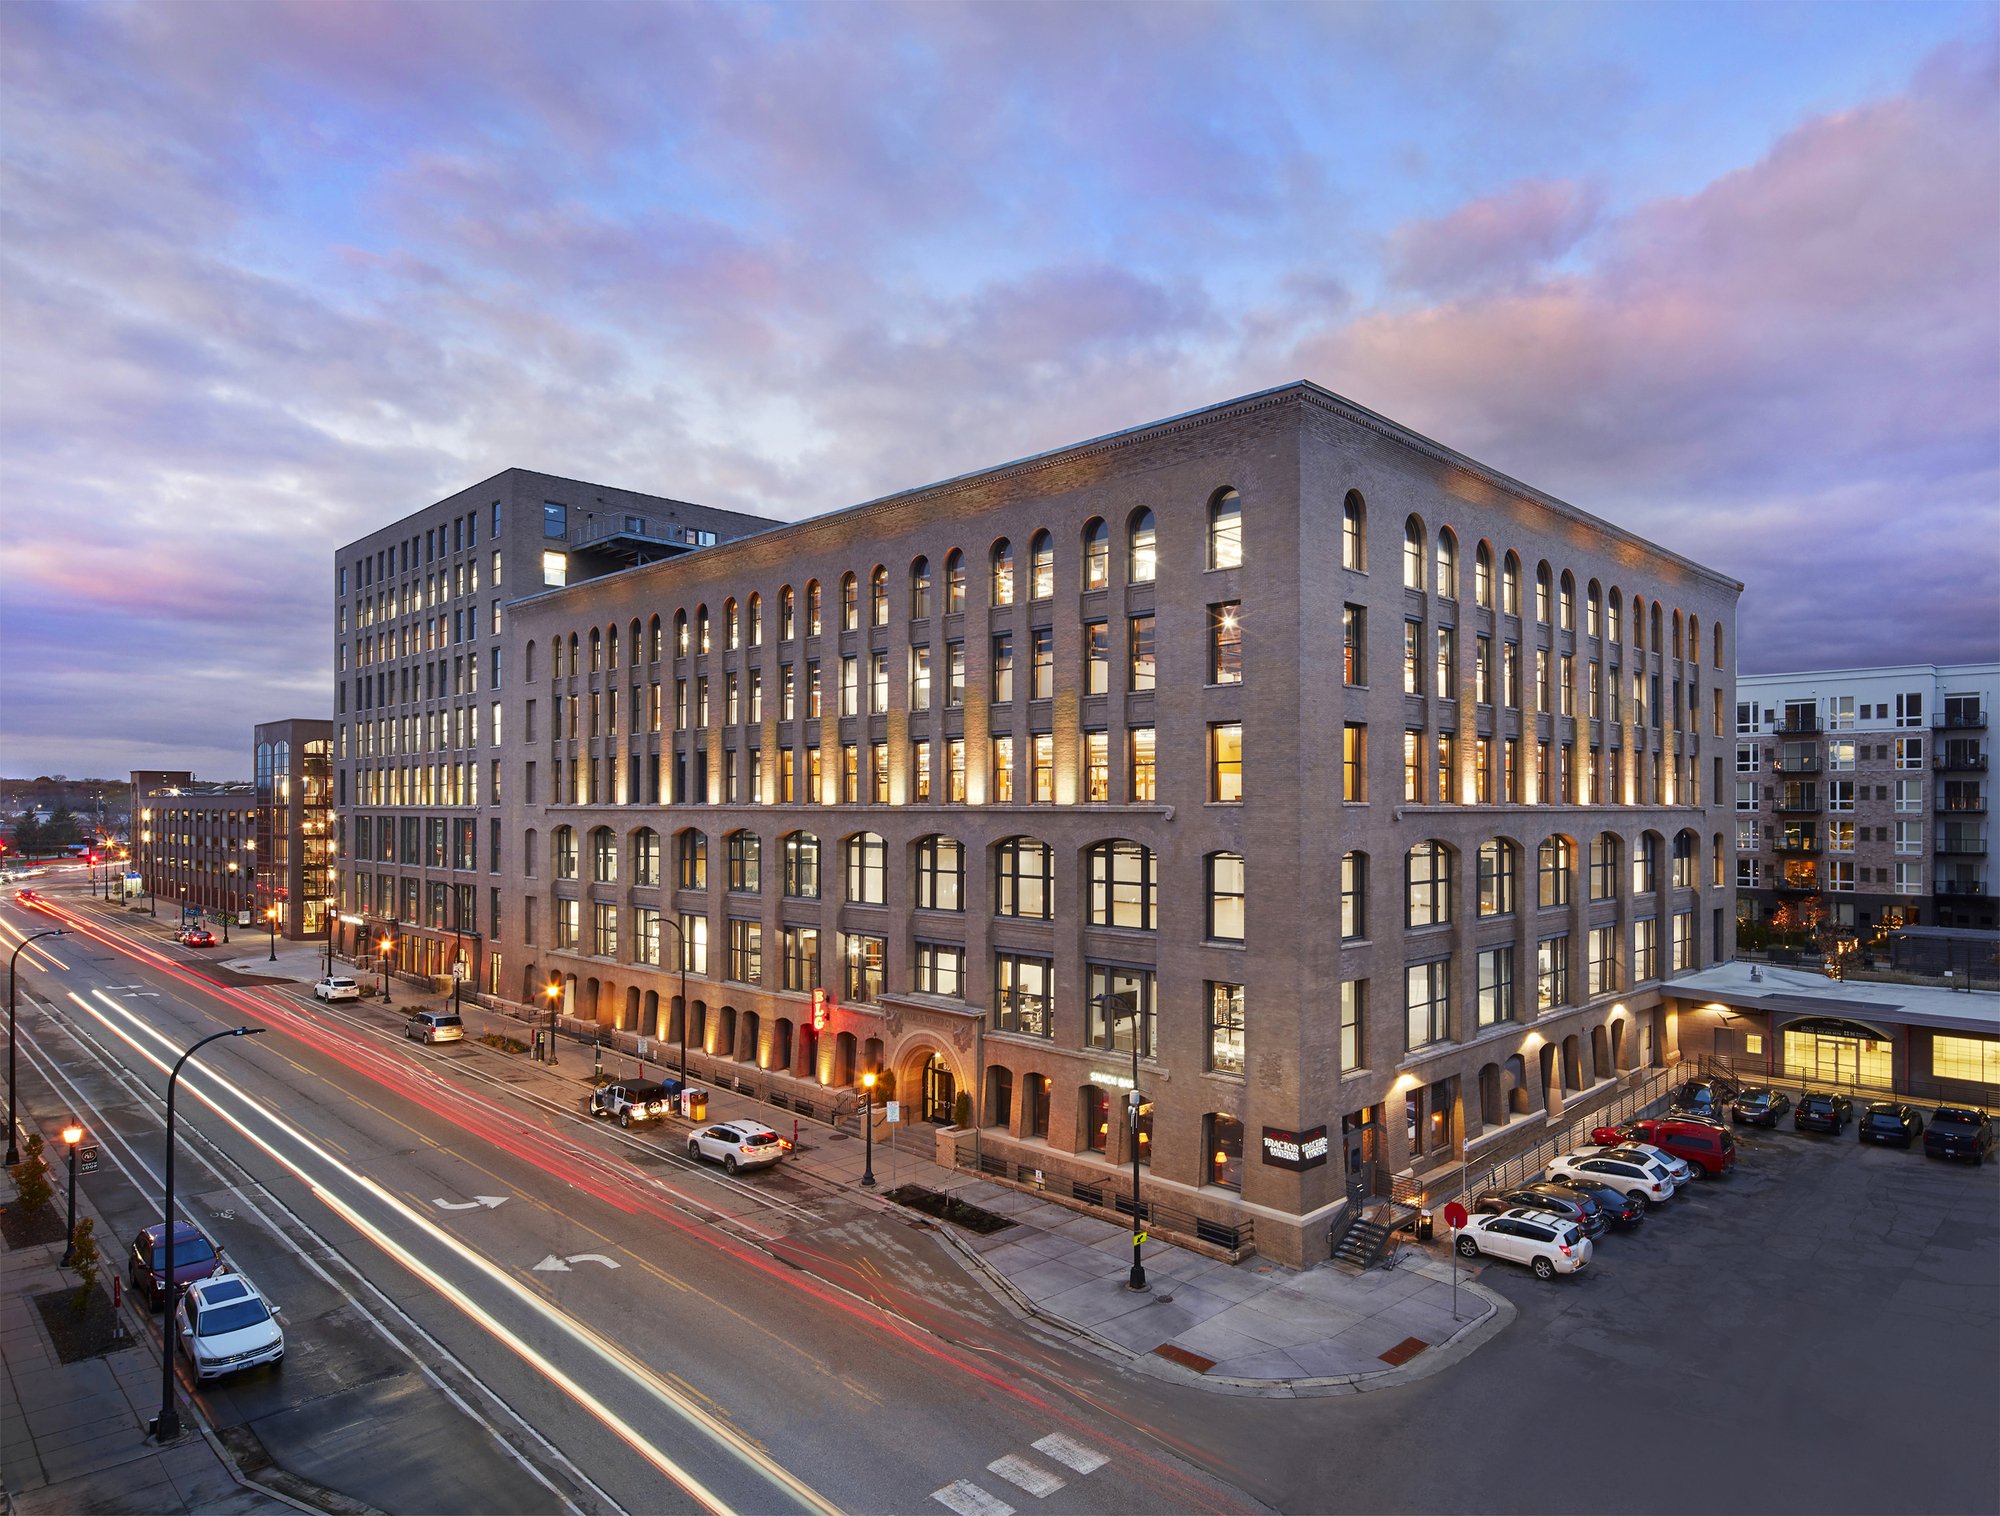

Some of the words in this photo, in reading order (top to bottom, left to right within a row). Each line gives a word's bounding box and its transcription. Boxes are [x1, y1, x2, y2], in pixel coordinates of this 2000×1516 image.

[814, 990, 824, 1030] BLG
[1090, 1071, 1117, 1086] SNACK
[1263, 1137, 1300, 1153] TRACTOR
[1269, 1147, 1300, 1162] WORKS
